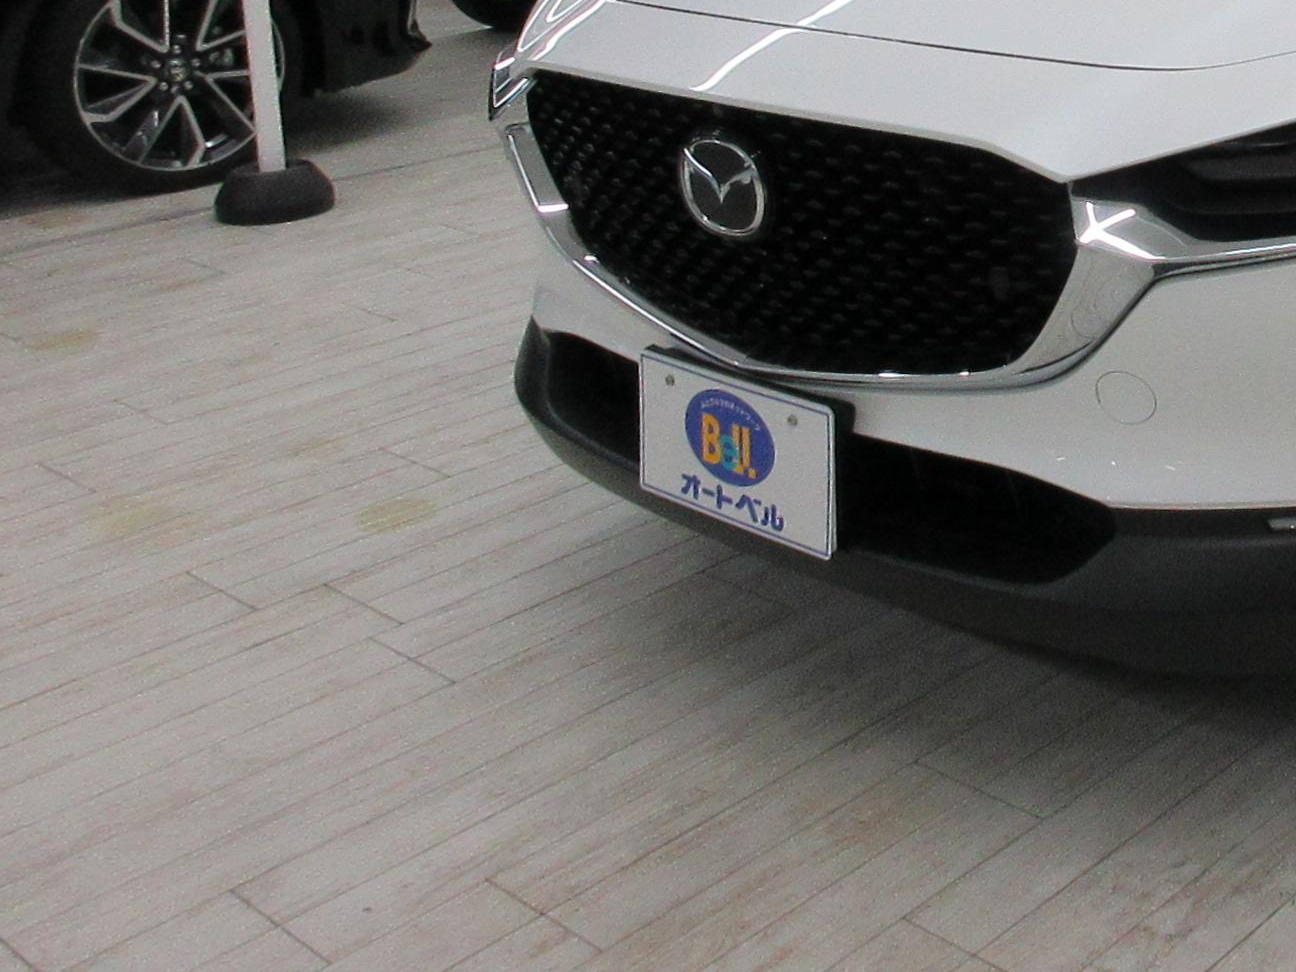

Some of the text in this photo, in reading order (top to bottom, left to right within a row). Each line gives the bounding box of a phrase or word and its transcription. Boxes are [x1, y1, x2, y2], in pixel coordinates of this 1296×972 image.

[680, 473, 785, 532] オートベル
